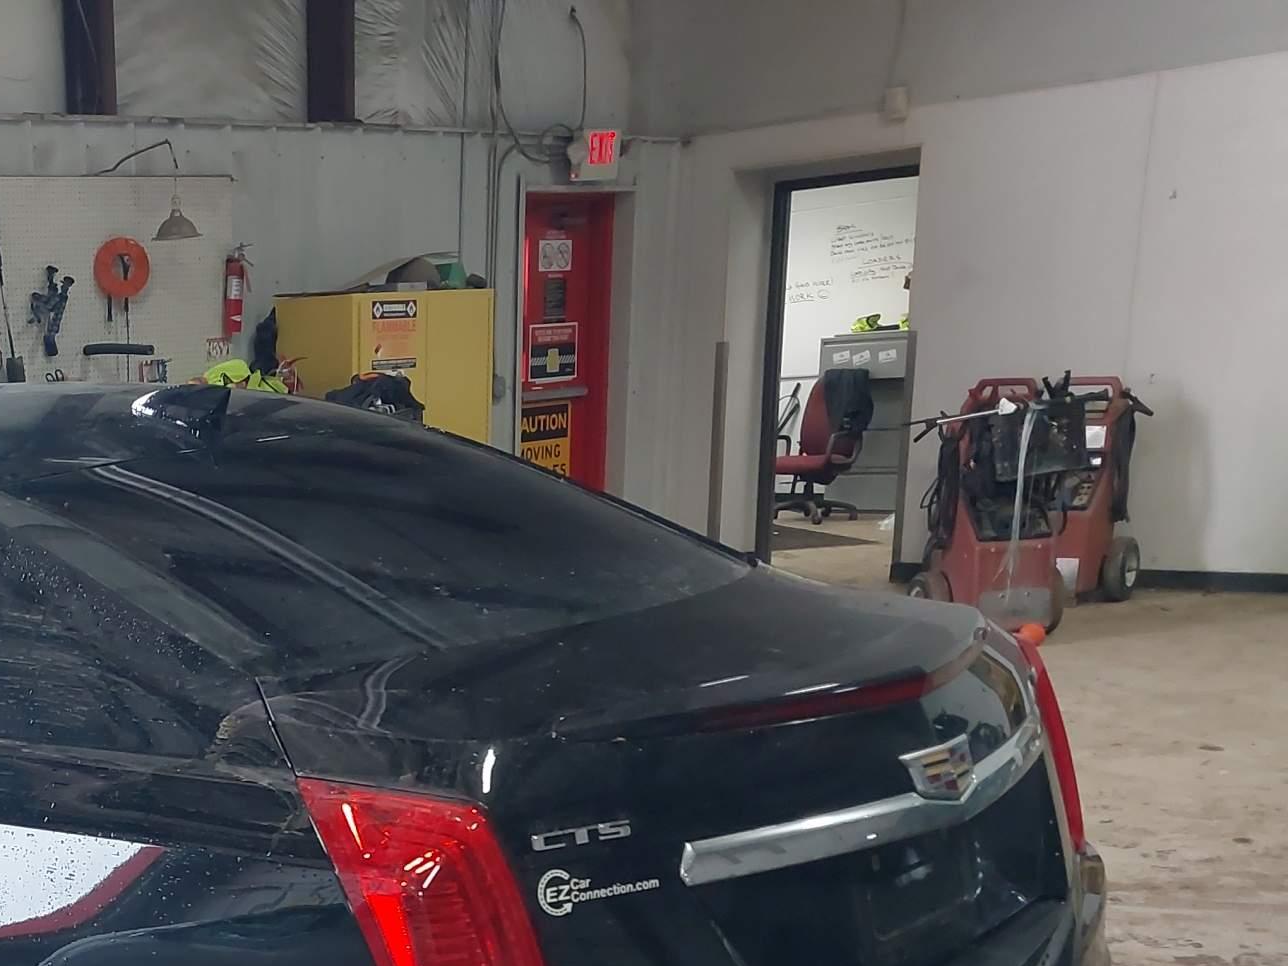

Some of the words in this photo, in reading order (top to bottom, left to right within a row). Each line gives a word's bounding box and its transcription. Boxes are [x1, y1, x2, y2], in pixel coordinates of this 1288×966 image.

[589, 131, 616, 165] EXIT
[521, 412, 567, 433] AUTION
[531, 819, 632, 852] CTS
[546, 884, 571, 903] EZ
[570, 878, 591, 890] Car
[571, 878, 660, 903] Connection.com
